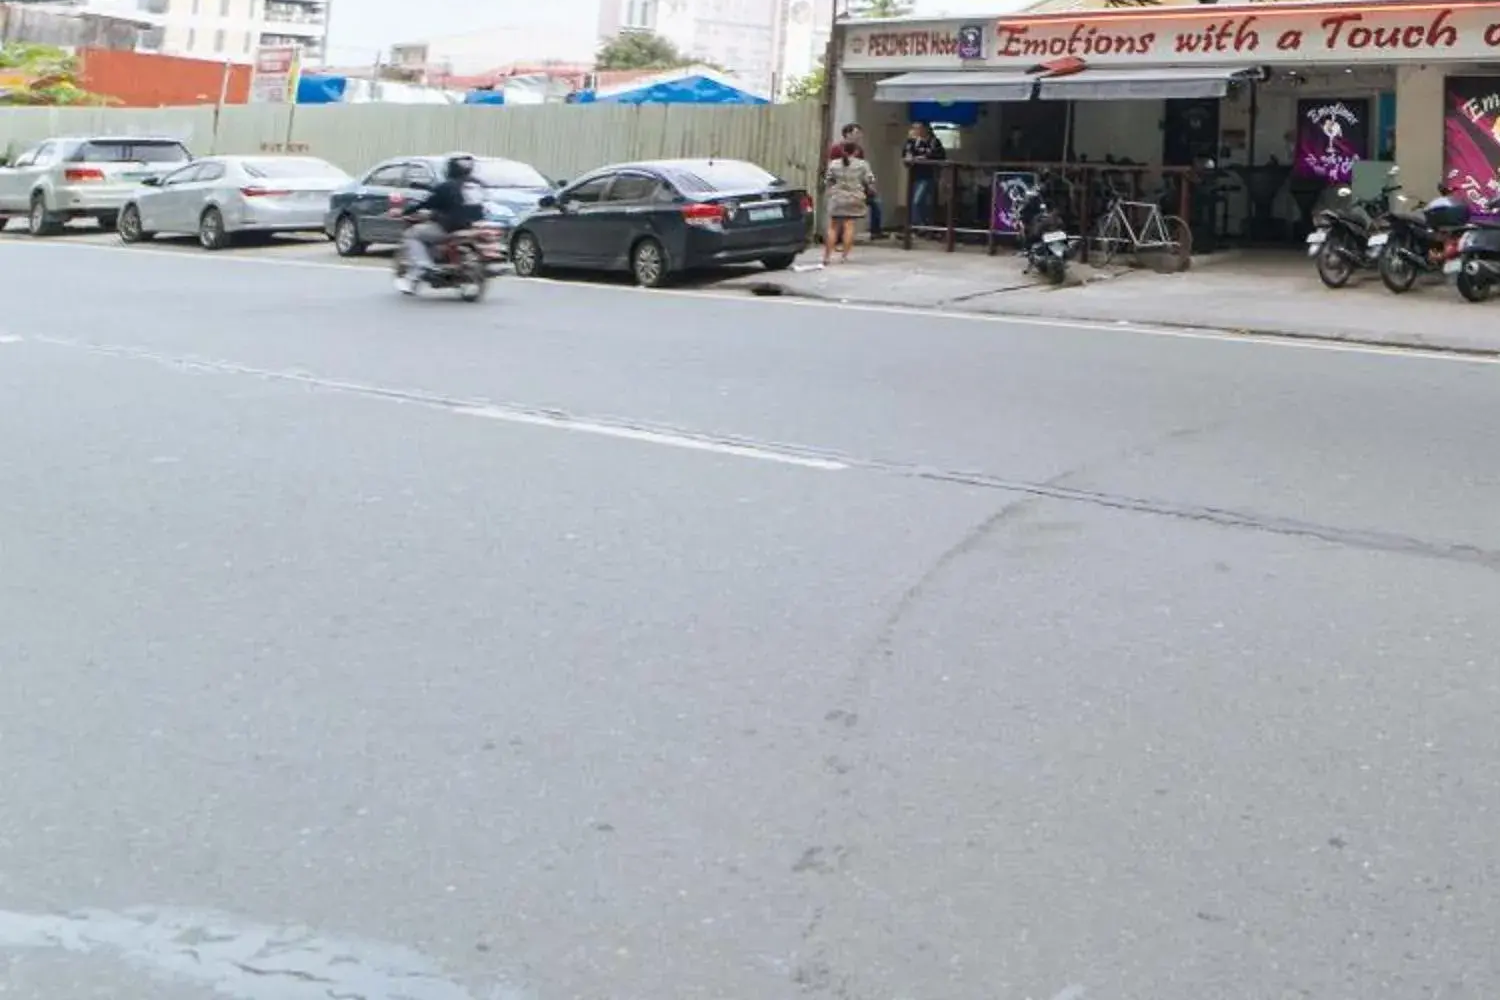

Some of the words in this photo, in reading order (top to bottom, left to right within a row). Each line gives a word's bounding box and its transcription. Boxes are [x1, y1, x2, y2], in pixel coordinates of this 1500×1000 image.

[868, 30, 930, 57] PERIMETER
[930, 30, 959, 55] Hote
[997, 22, 1156, 57] Emotions
[1175, 15, 1259, 53] with
[1276, 29, 1302, 50] a
[1321, 8, 1458, 50] Touch
